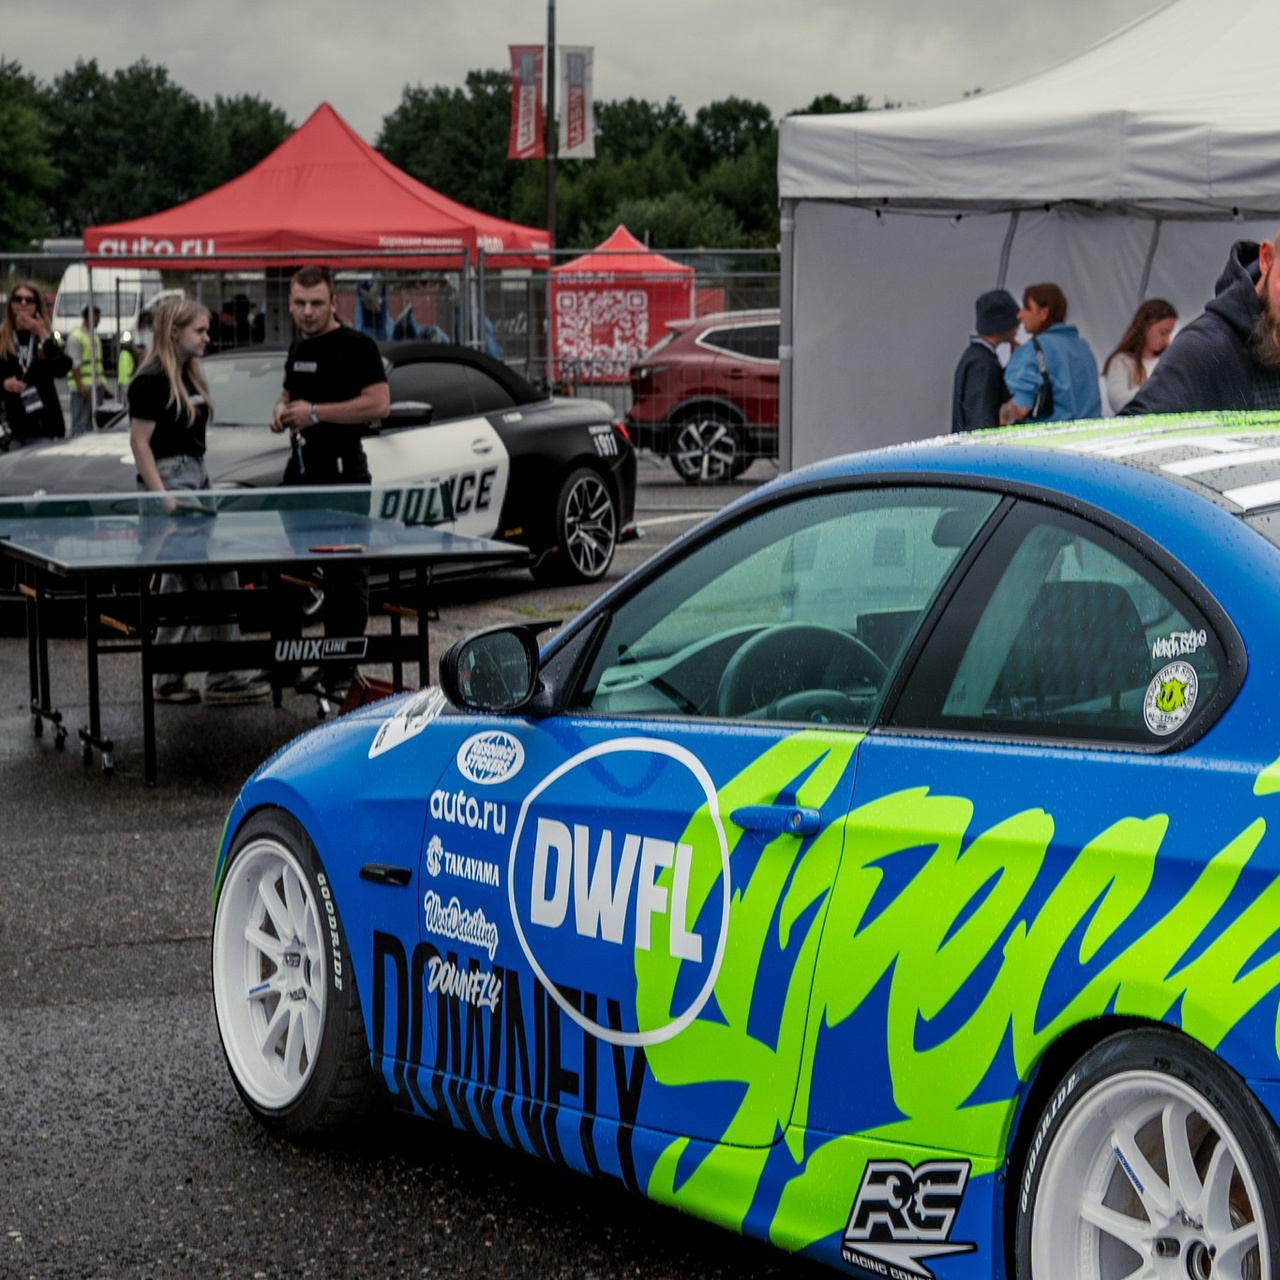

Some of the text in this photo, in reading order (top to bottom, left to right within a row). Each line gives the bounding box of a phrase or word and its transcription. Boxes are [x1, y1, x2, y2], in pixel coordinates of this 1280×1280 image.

[98, 236, 215, 256] autoru
[275, 639, 348, 661] UNIX LINE
[430, 789, 506, 835] auto.ru
[444, 851, 499, 887] TAKAYAMA
[530, 817, 702, 963] DWFL
[317, 872, 342, 991] GOODRIDE
[1021, 1073, 1076, 1213] GOODRIDE
[842, 1249, 888, 1276] RACING
